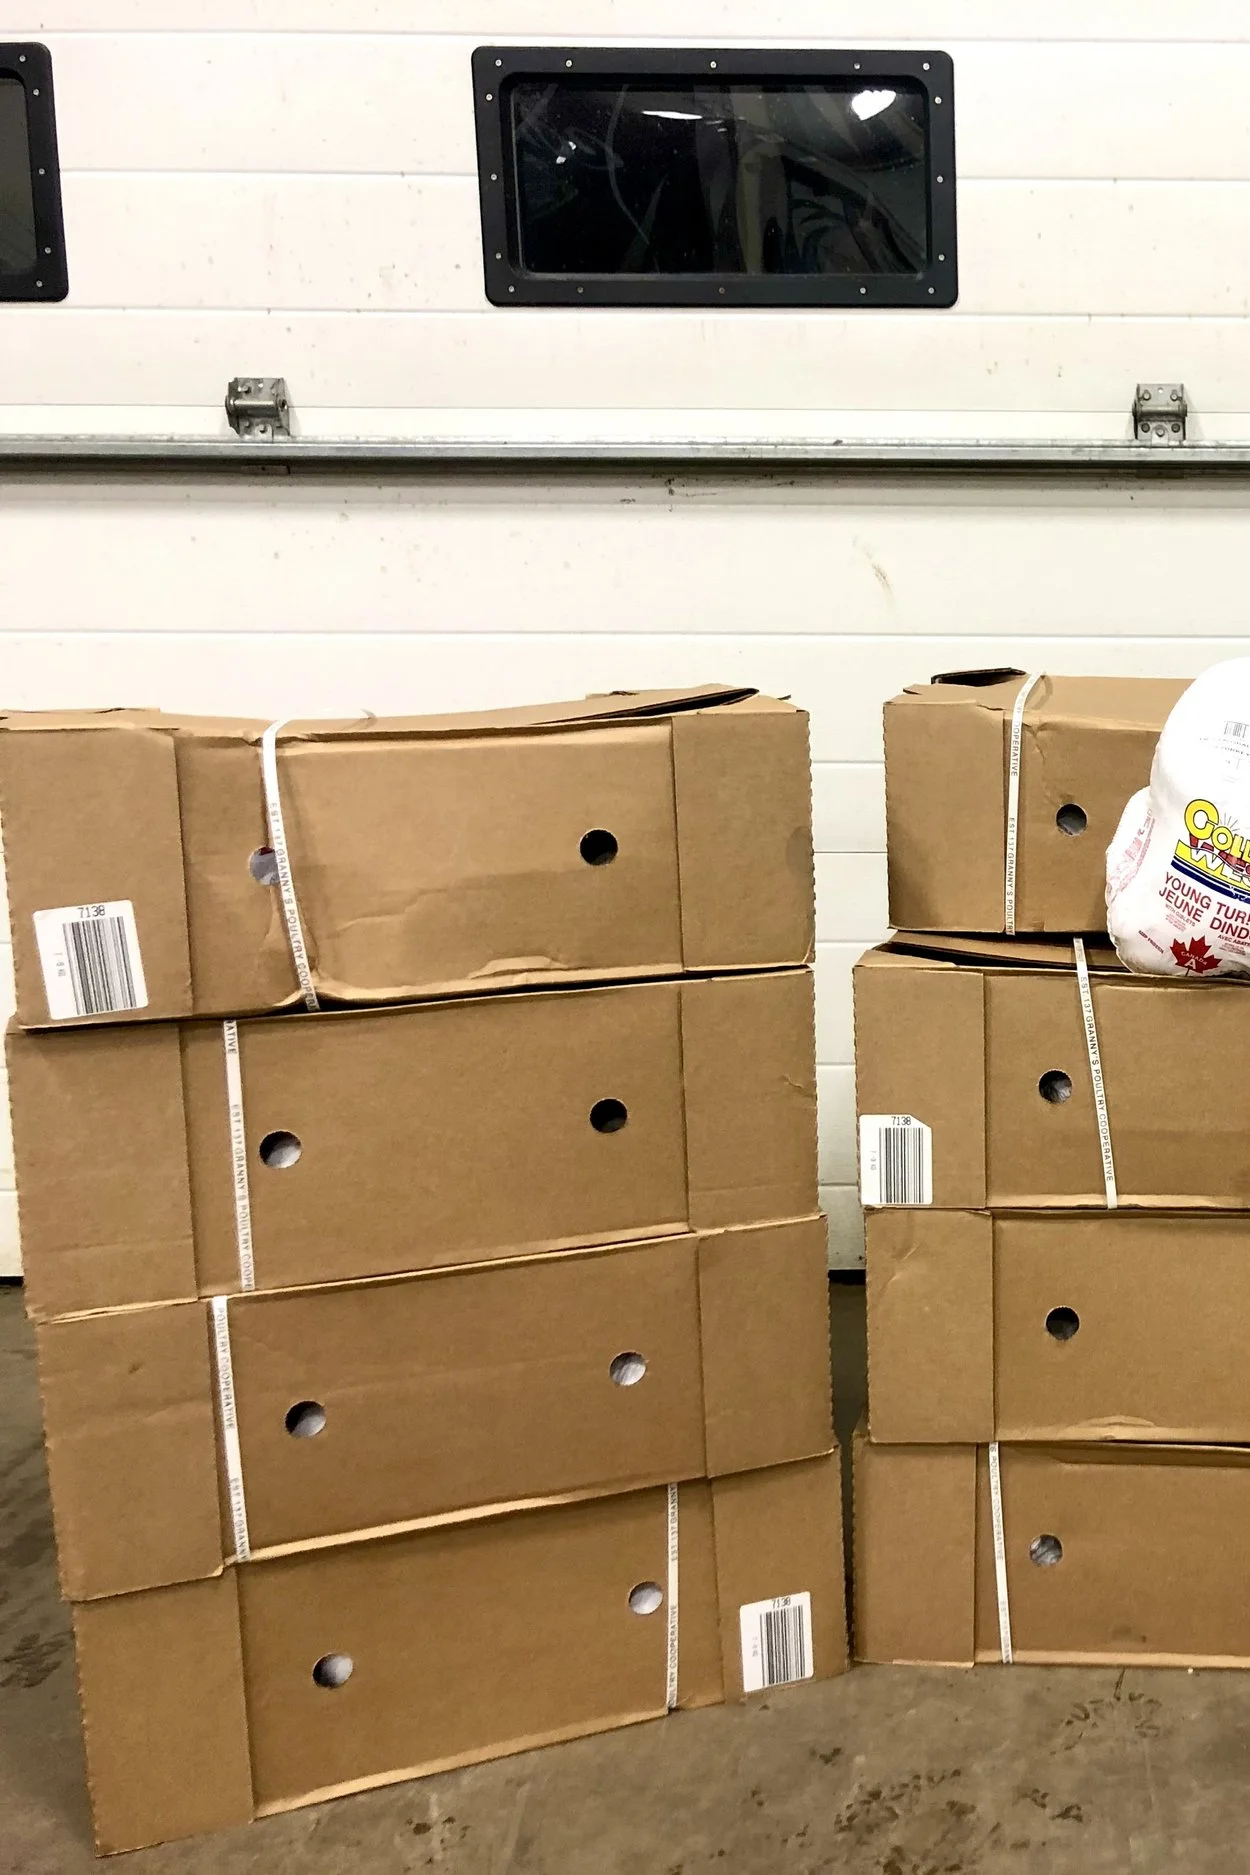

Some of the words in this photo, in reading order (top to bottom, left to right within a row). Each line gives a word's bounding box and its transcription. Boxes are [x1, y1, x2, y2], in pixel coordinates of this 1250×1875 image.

[1006, 852, 1014, 896] GRANNY'S
[1162, 872, 1212, 910] YOUNG
[77, 904, 106, 918] 7138
[1005, 898, 1014, 934] POULTRY
[1158, 887, 1204, 923] JEUNE
[286, 908, 305, 958] POULTRY
[1184, 958, 1197, 970] A
[1082, 998, 1092, 1014] 137
[1084, 1016, 1099, 1066] GRANNY'S
[1092, 1068, 1105, 1112] POULTRY
[891, 1116, 912, 1126] 7138
[1097, 1112, 1114, 1182] COOPERATIVE
